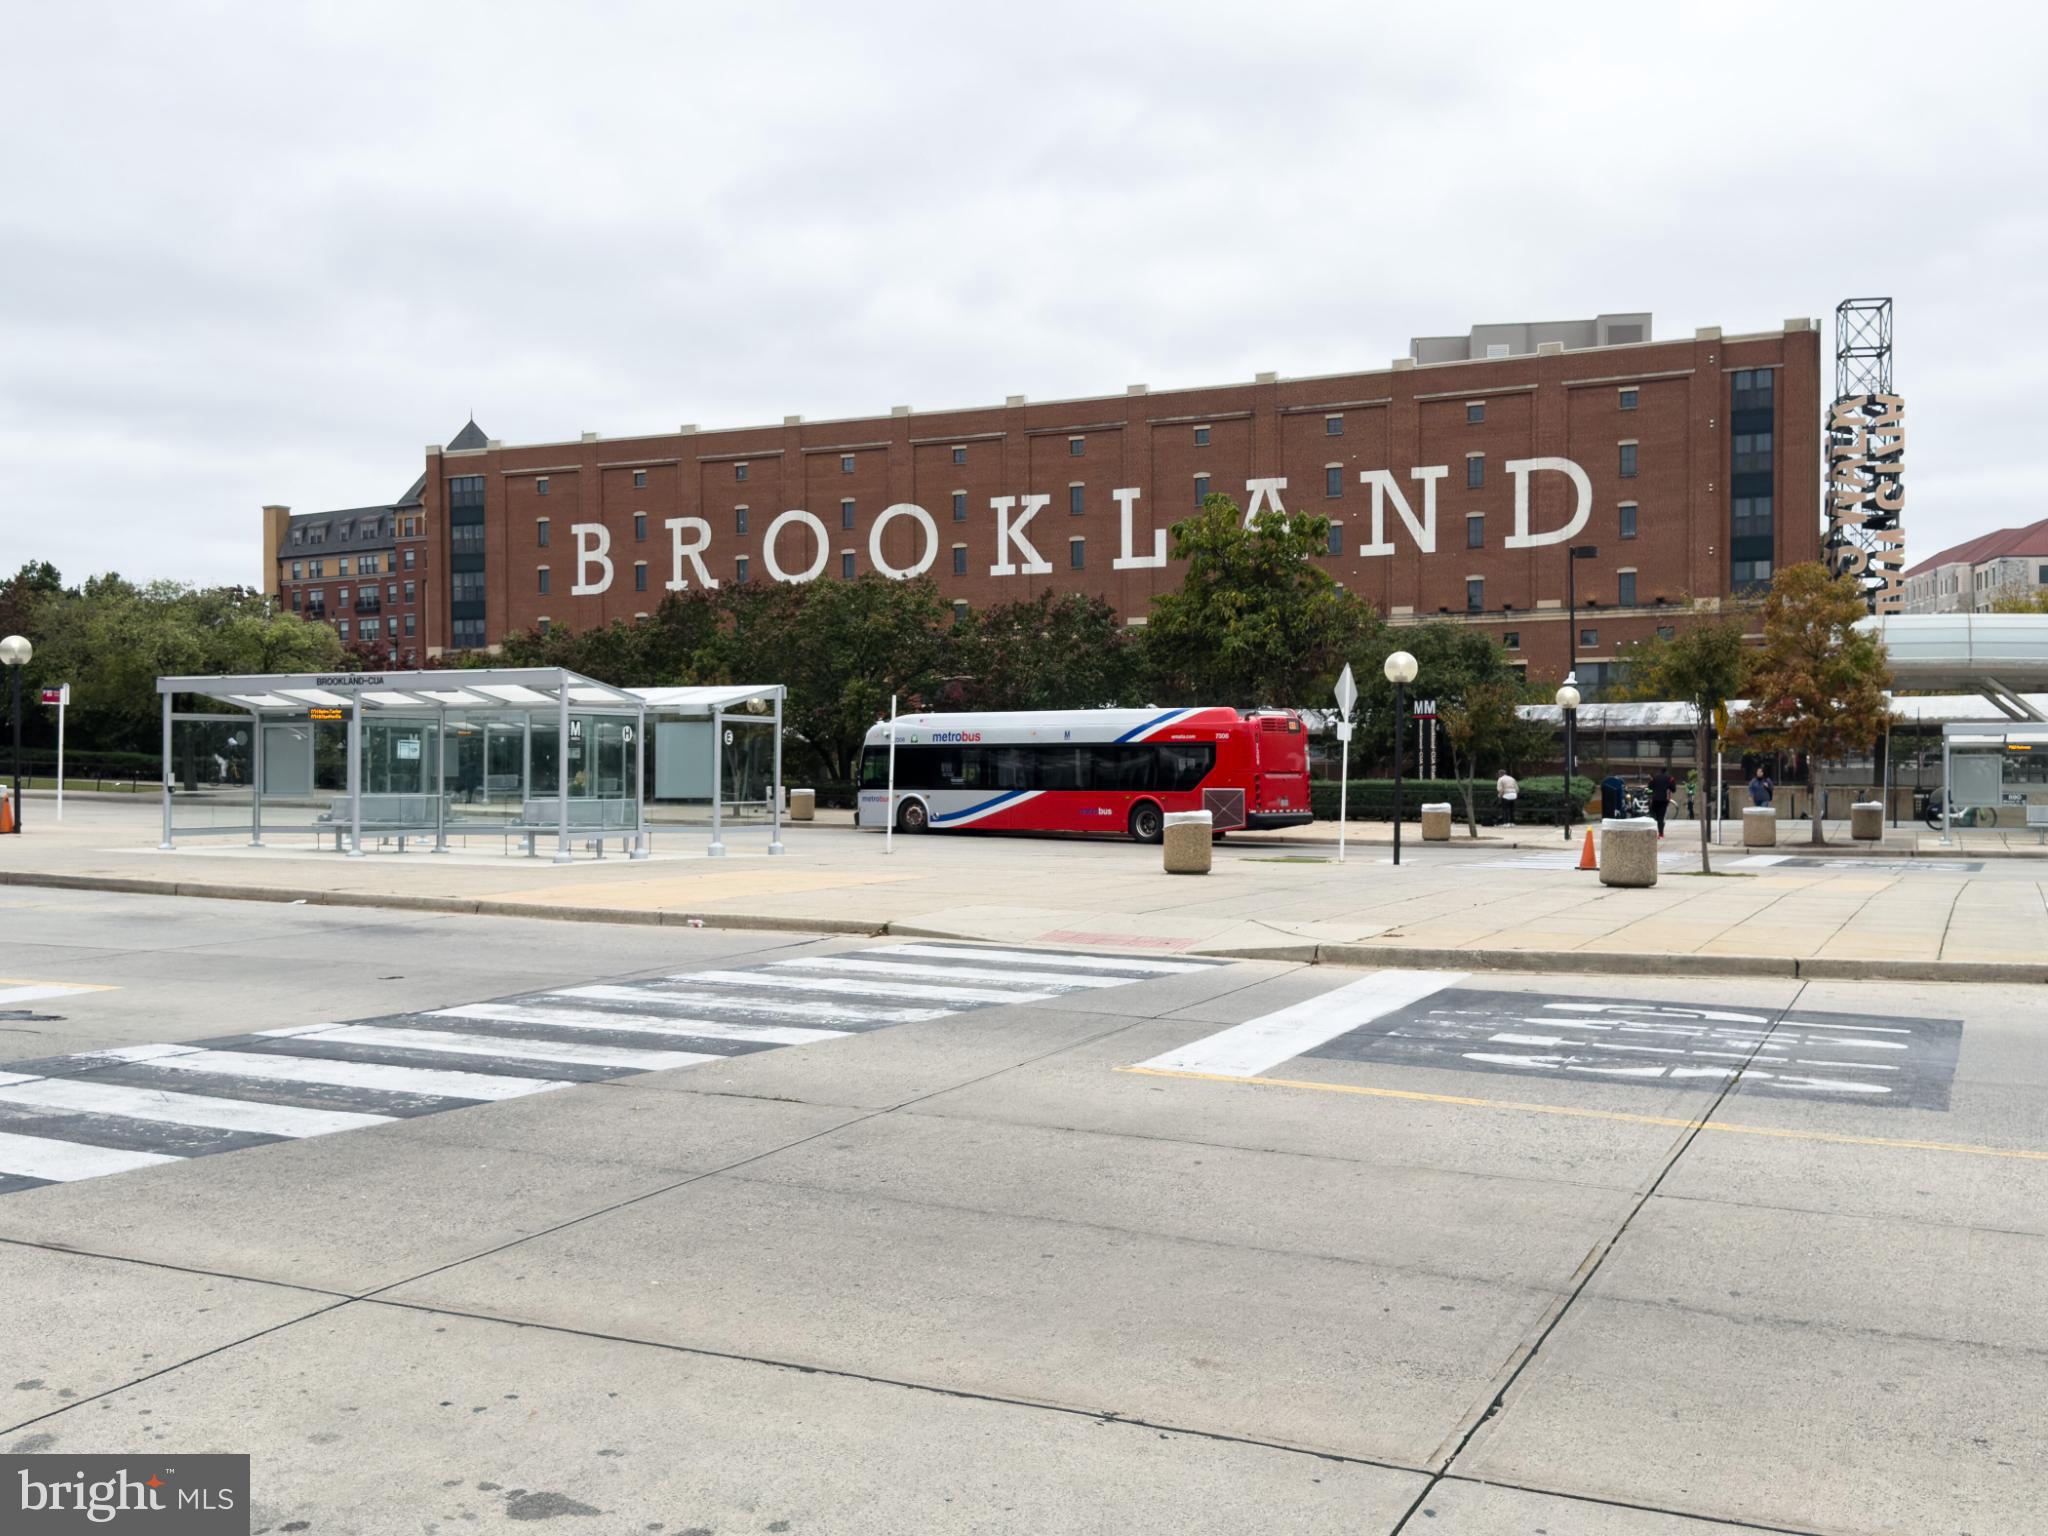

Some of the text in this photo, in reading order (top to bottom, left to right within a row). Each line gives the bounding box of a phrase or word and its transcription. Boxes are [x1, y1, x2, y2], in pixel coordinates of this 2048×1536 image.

[571, 456, 1593, 597] BROOKLAND
[316, 677, 384, 686] BROOKLAND-CUA
[570, 721, 581, 736] M
[932, 731, 981, 742] metrobus
